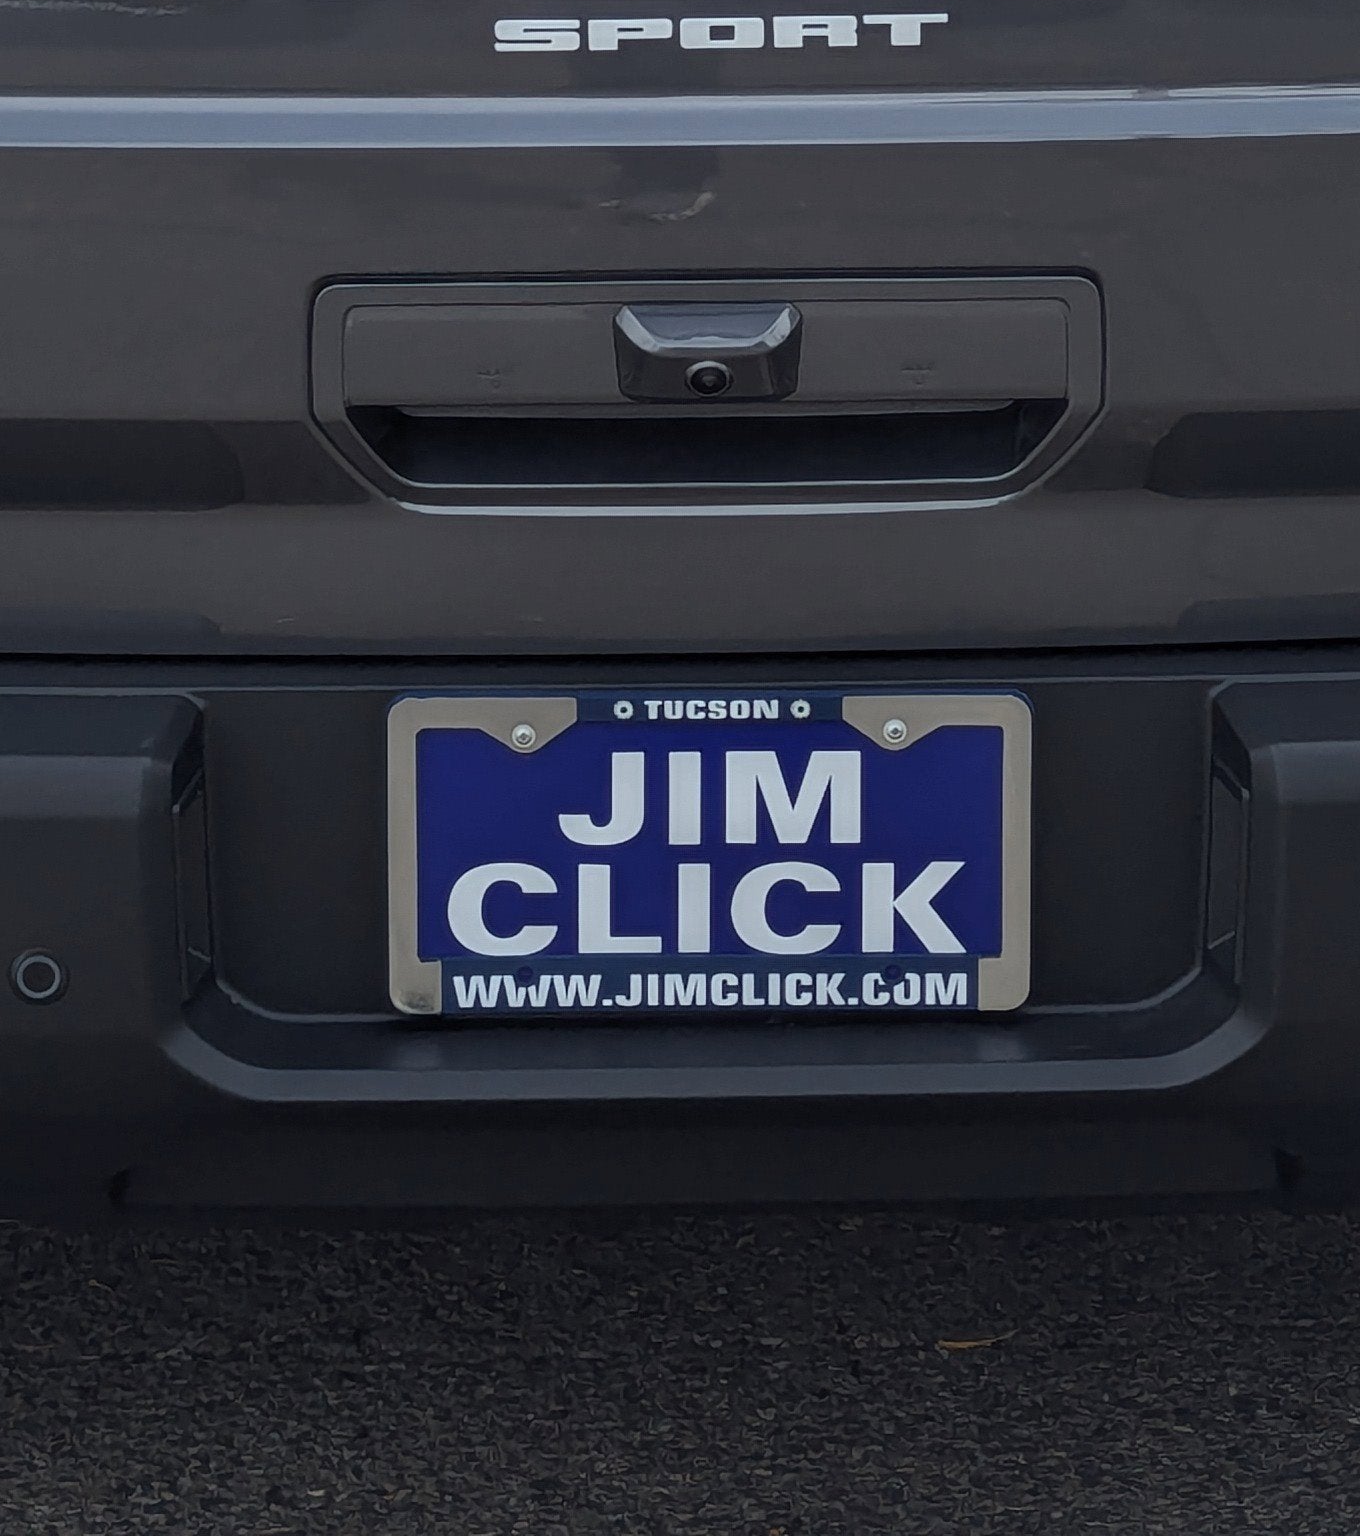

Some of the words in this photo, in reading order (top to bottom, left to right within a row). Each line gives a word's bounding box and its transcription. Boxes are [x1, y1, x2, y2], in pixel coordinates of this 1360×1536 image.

[494, 13, 949, 52] SPORT
[643, 699, 779, 720] TUCSON
[557, 750, 862, 846] JIM
[447, 861, 967, 957] CLICK
[452, 972, 968, 1009] WWW.JIMCLICK.COM
